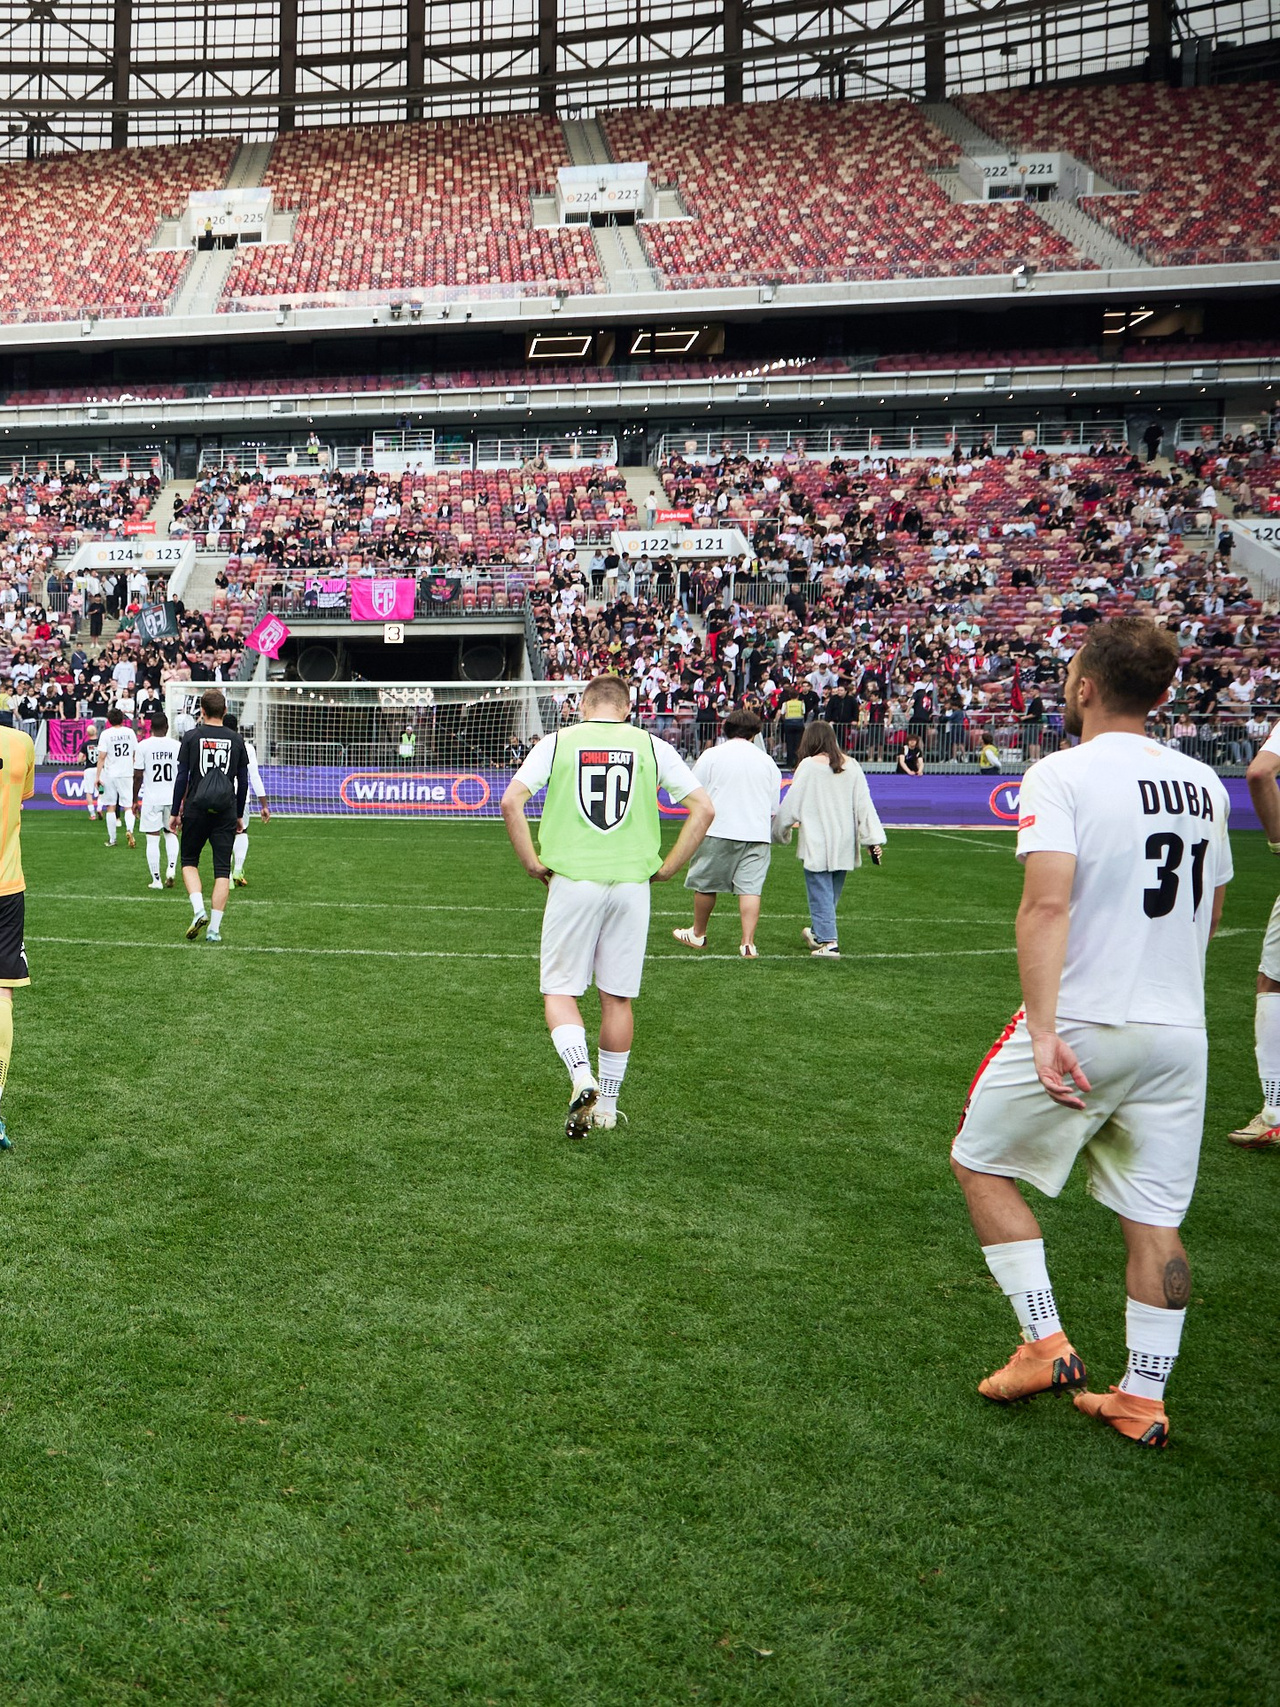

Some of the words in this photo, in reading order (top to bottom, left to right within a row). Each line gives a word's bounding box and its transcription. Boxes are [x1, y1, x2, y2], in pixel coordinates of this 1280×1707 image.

[983, 166, 1008, 177] 222
[1029, 163, 1053, 175] 221
[576, 192, 598, 202] 224
[617, 189, 639, 199] 223
[206, 216, 226, 225] 26
[243, 213, 263, 223] 225
[640, 538, 669, 551] 122
[695, 537, 724, 550] 121
[109, 549, 133, 560] 124
[156, 548, 182, 559] 123
[388, 626, 400, 641] 3
[114, 743, 129, 757] 52
[581, 752, 632, 764] СИНДЕКАТ
[153, 763, 173, 782] 20
[354, 781, 446, 801] Winline
[581, 765, 630, 827] FC
[1138, 780, 1214, 822] DUBA
[1143, 832, 1209, 922] 31
